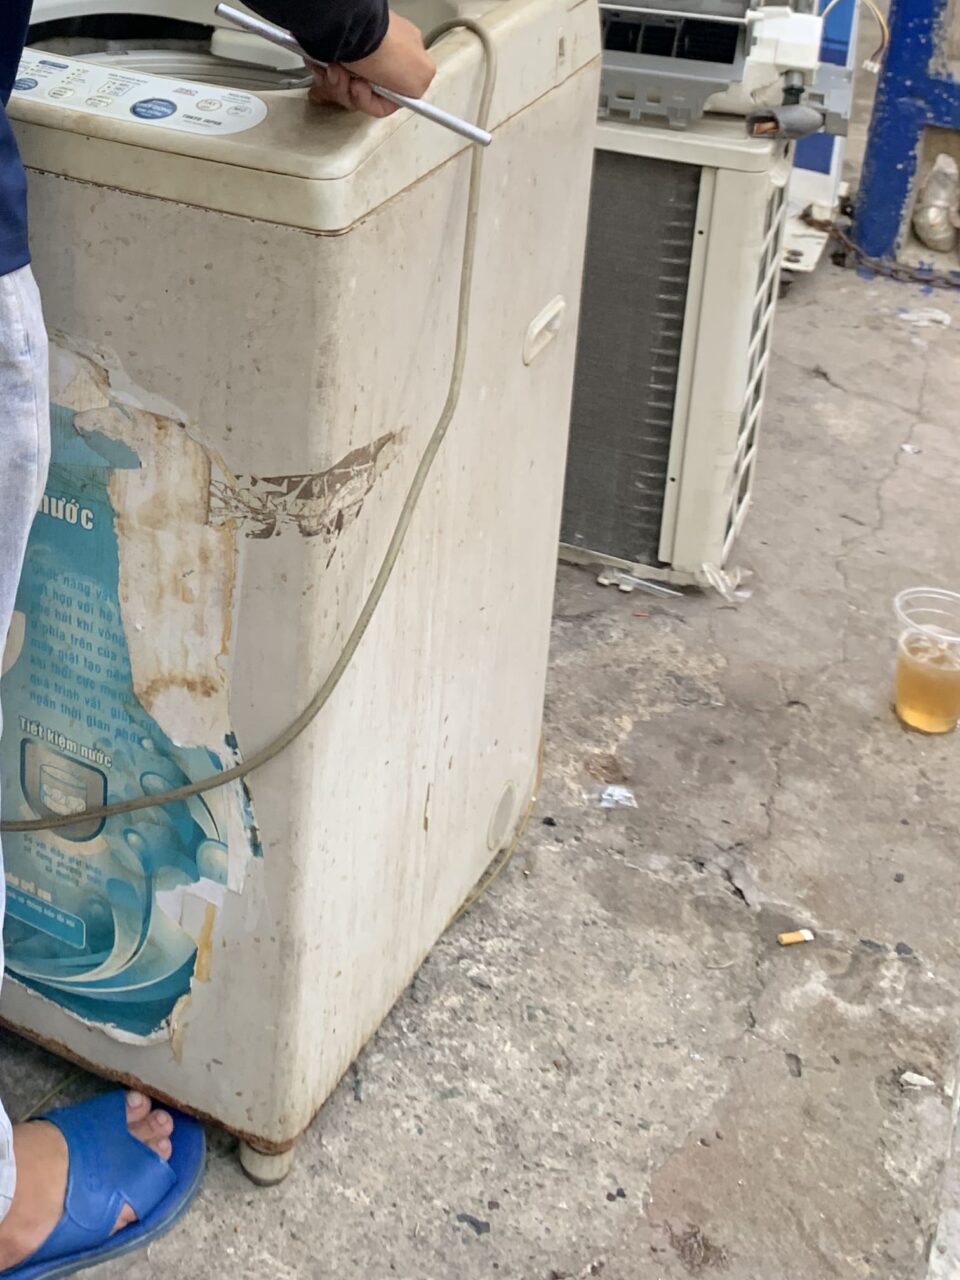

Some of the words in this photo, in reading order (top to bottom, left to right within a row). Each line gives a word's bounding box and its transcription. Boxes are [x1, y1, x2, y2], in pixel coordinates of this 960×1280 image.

[38, 494, 94, 530] nước
[20, 716, 45, 739] Tiết
[47, 729, 78, 754] kiệm
[81, 745, 113, 769] nước
